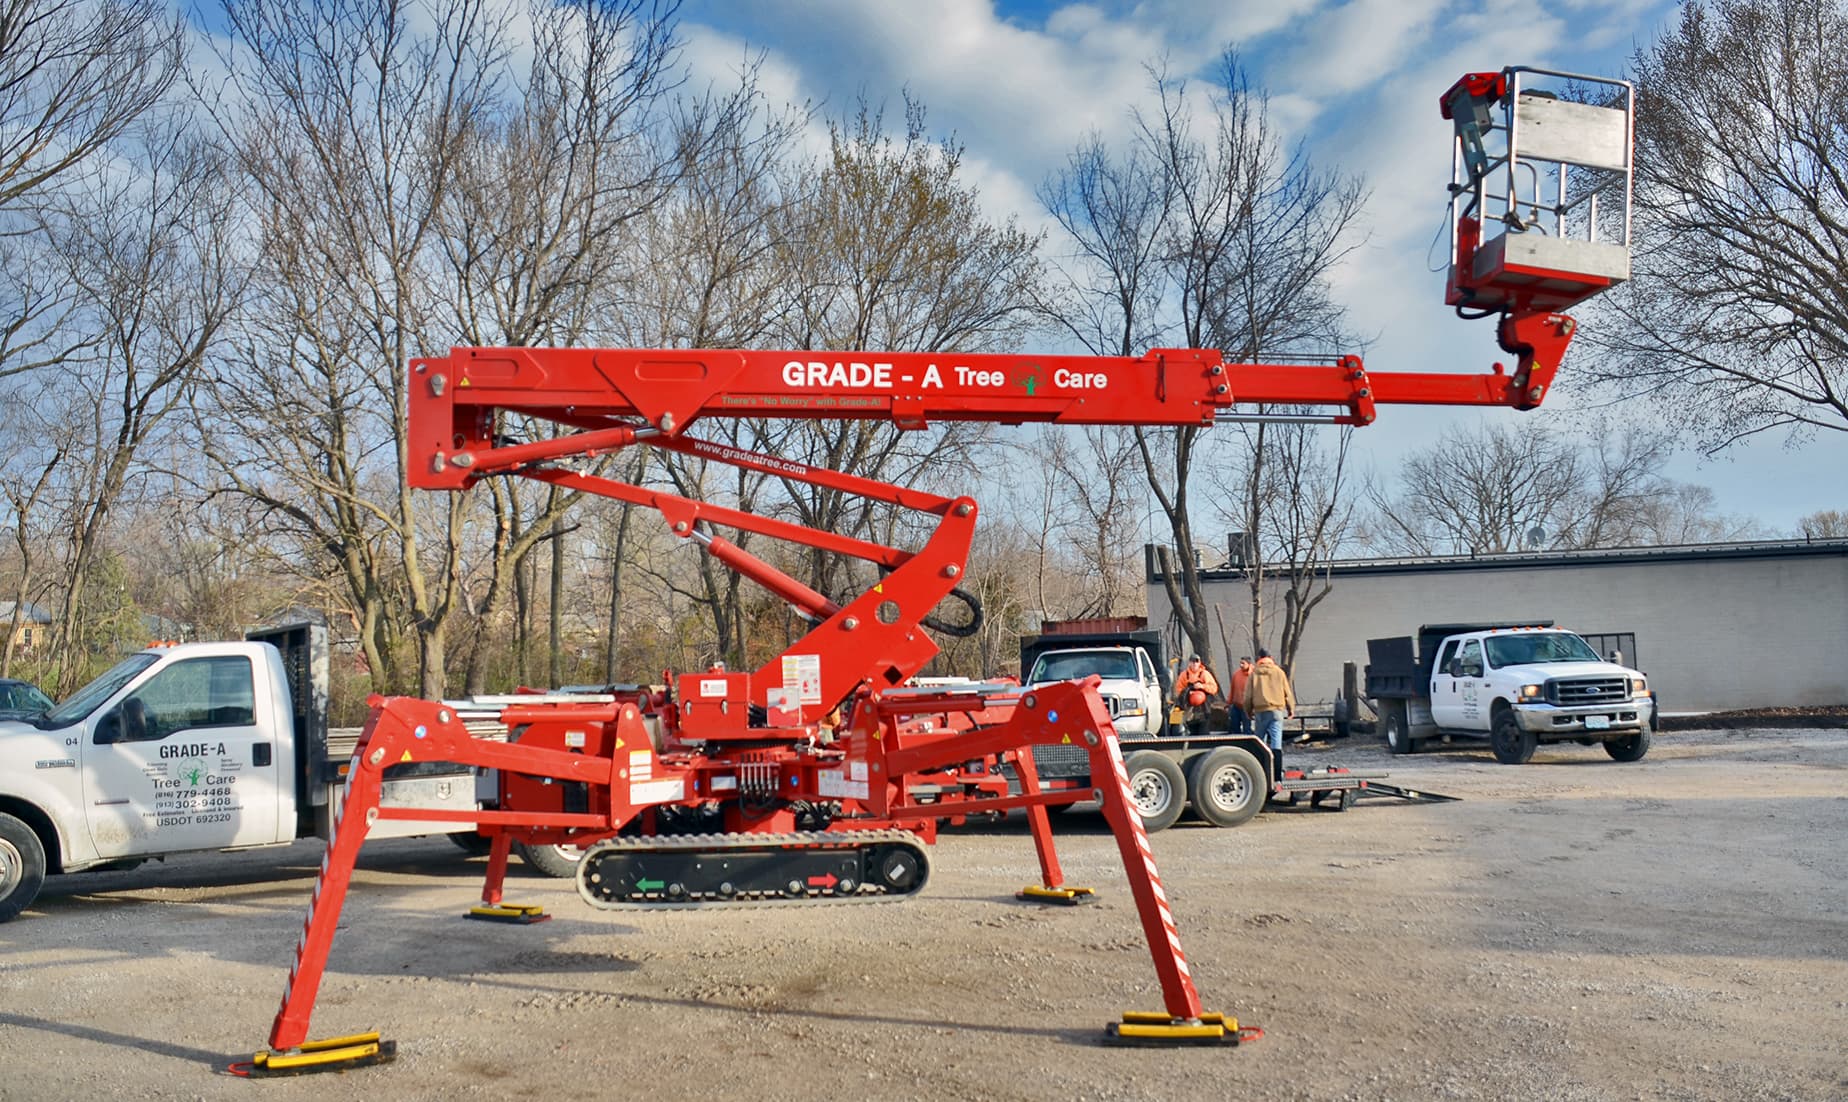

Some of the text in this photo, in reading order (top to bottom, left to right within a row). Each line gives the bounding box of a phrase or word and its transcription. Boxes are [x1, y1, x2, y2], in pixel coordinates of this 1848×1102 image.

[782, 361, 892, 388] GRADE
[921, 364, 943, 388] A
[954, 367, 1005, 387] Tree
[1054, 369, 1108, 389] Care
[722, 396, 756, 405] There's
[816, 398, 836, 406] with
[694, 441, 807, 475] www.gradeatree.com
[160, 742, 226, 758] GRADE-A
[152, 775, 236, 789] Tree Care
[176, 787, 231, 798] 779-4468
[175, 798, 231, 808] 302-9408
[157, 814, 231, 827] USDOT 692320
